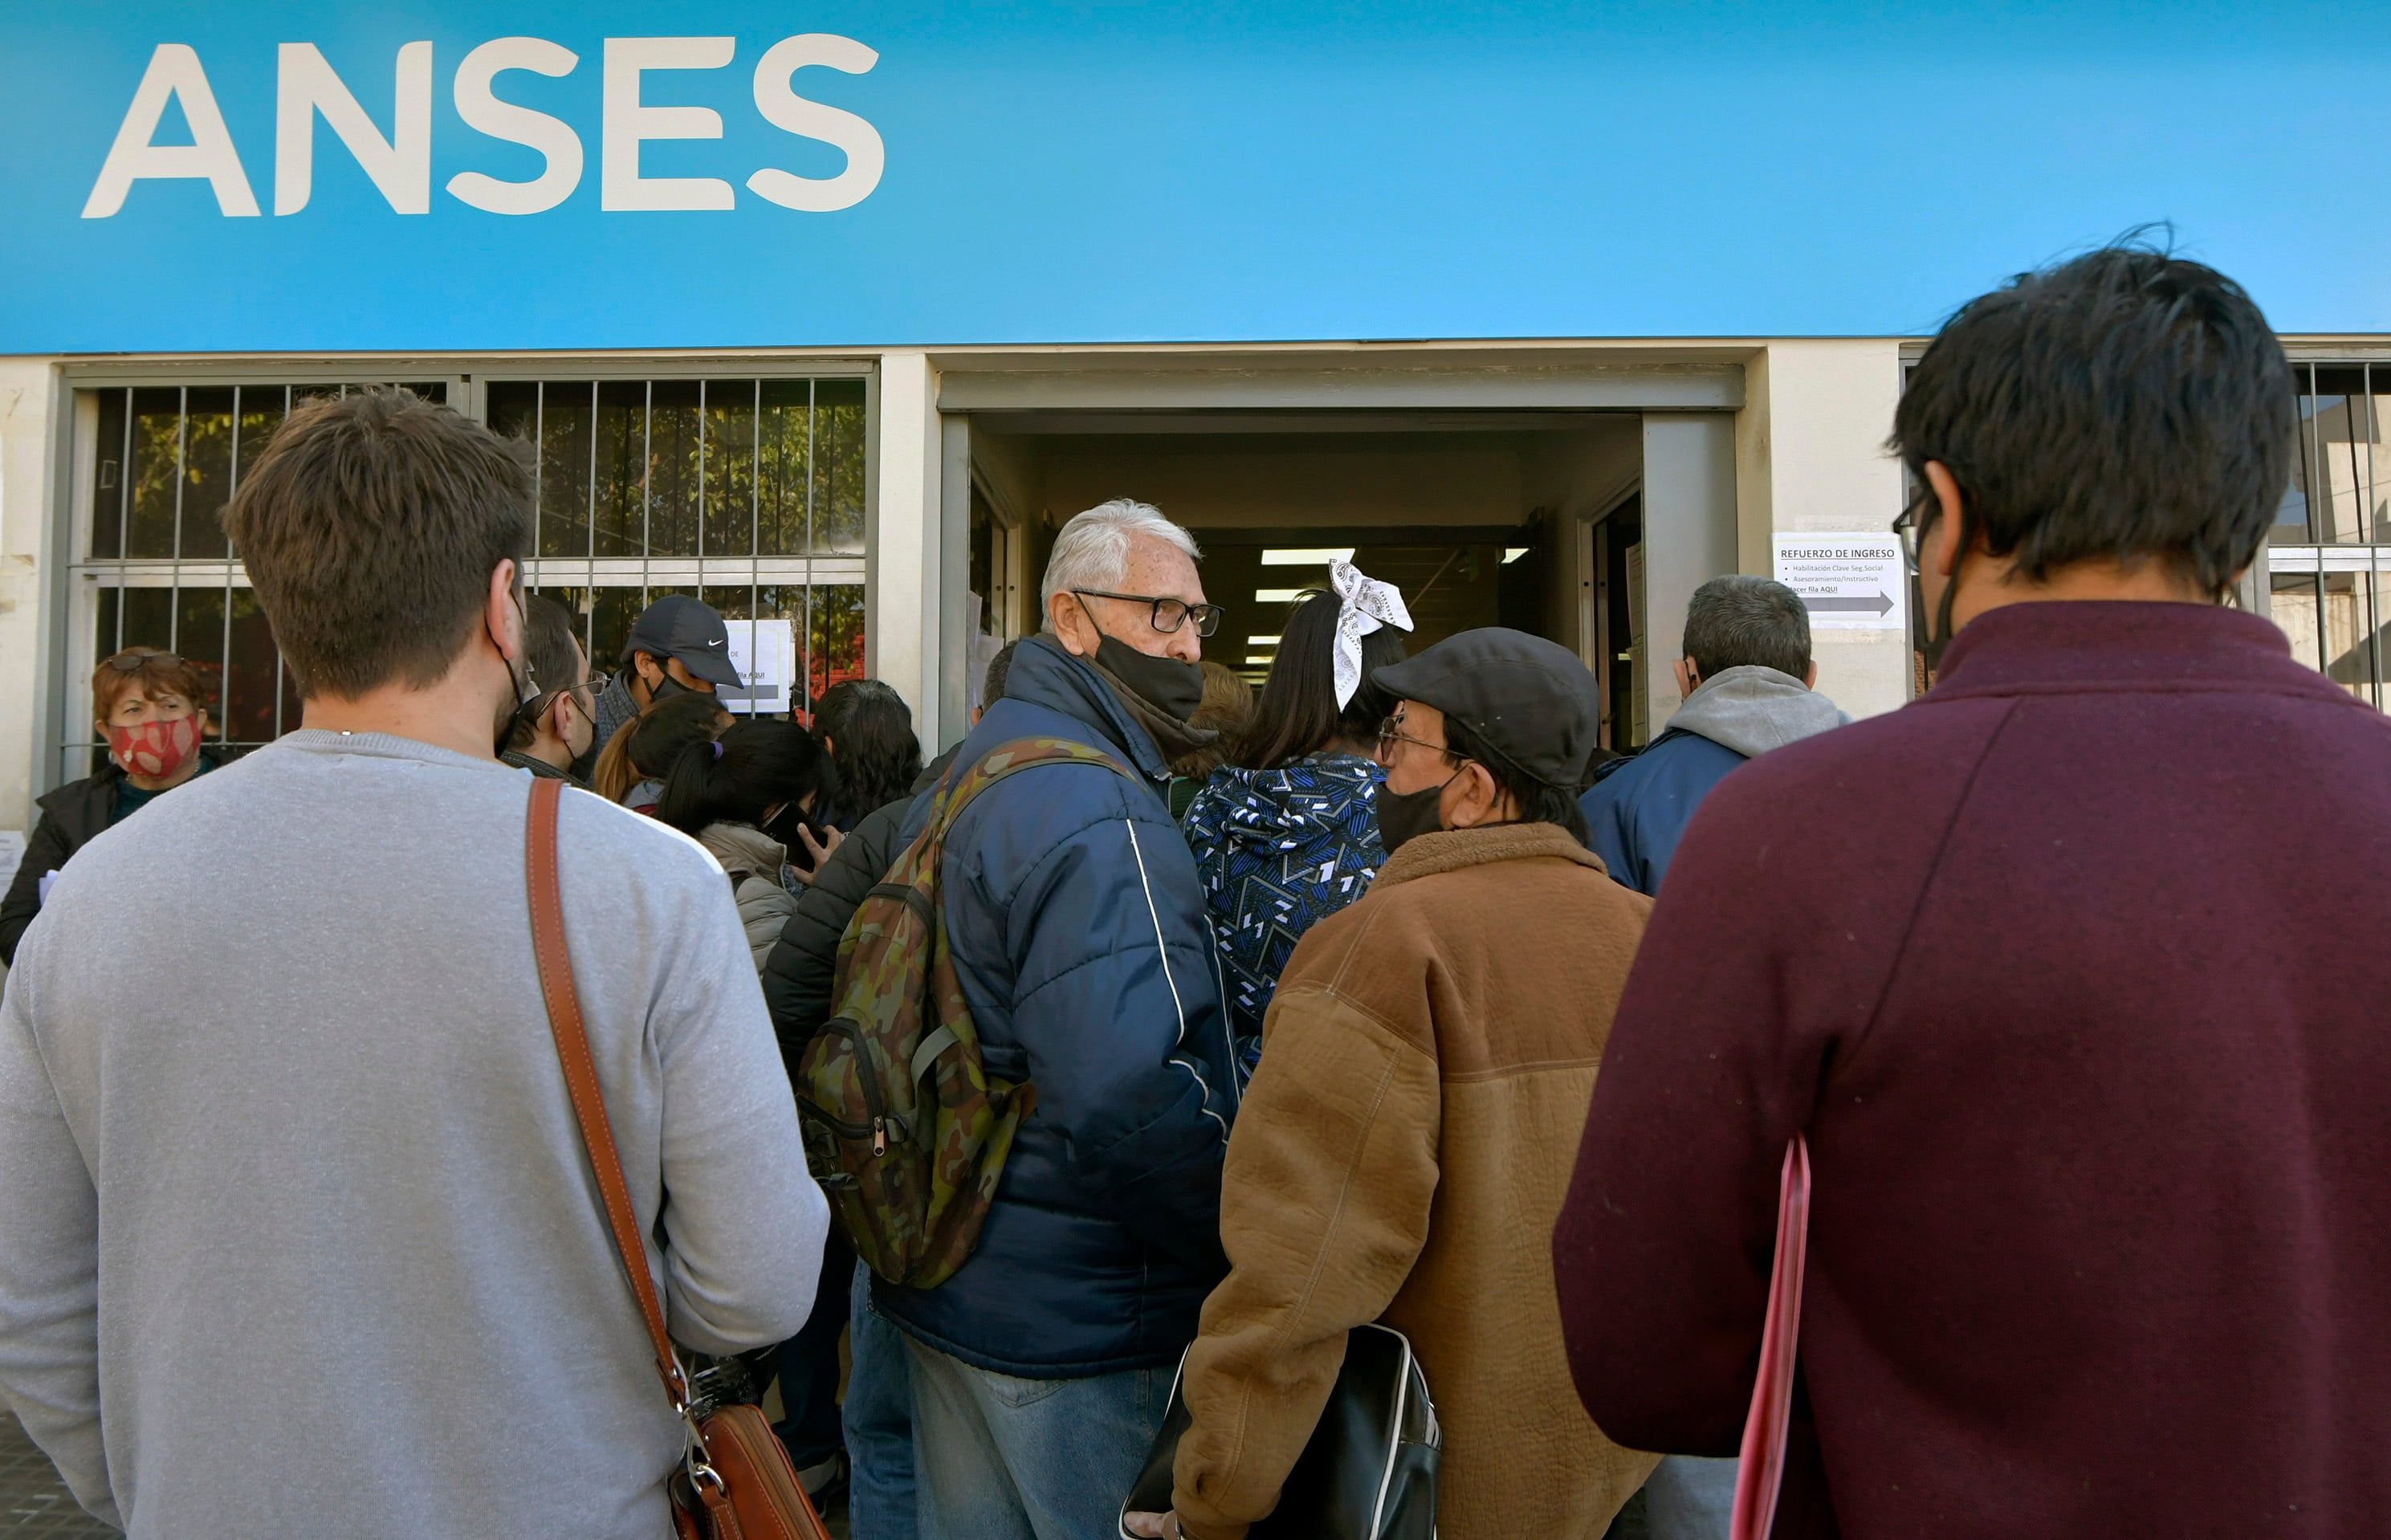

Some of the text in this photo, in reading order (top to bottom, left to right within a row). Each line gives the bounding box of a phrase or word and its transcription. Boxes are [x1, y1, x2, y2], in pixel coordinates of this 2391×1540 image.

[80, 32, 885, 218] ANSES
[1781, 549, 1895, 558] REFUERZO DE INGRESO
